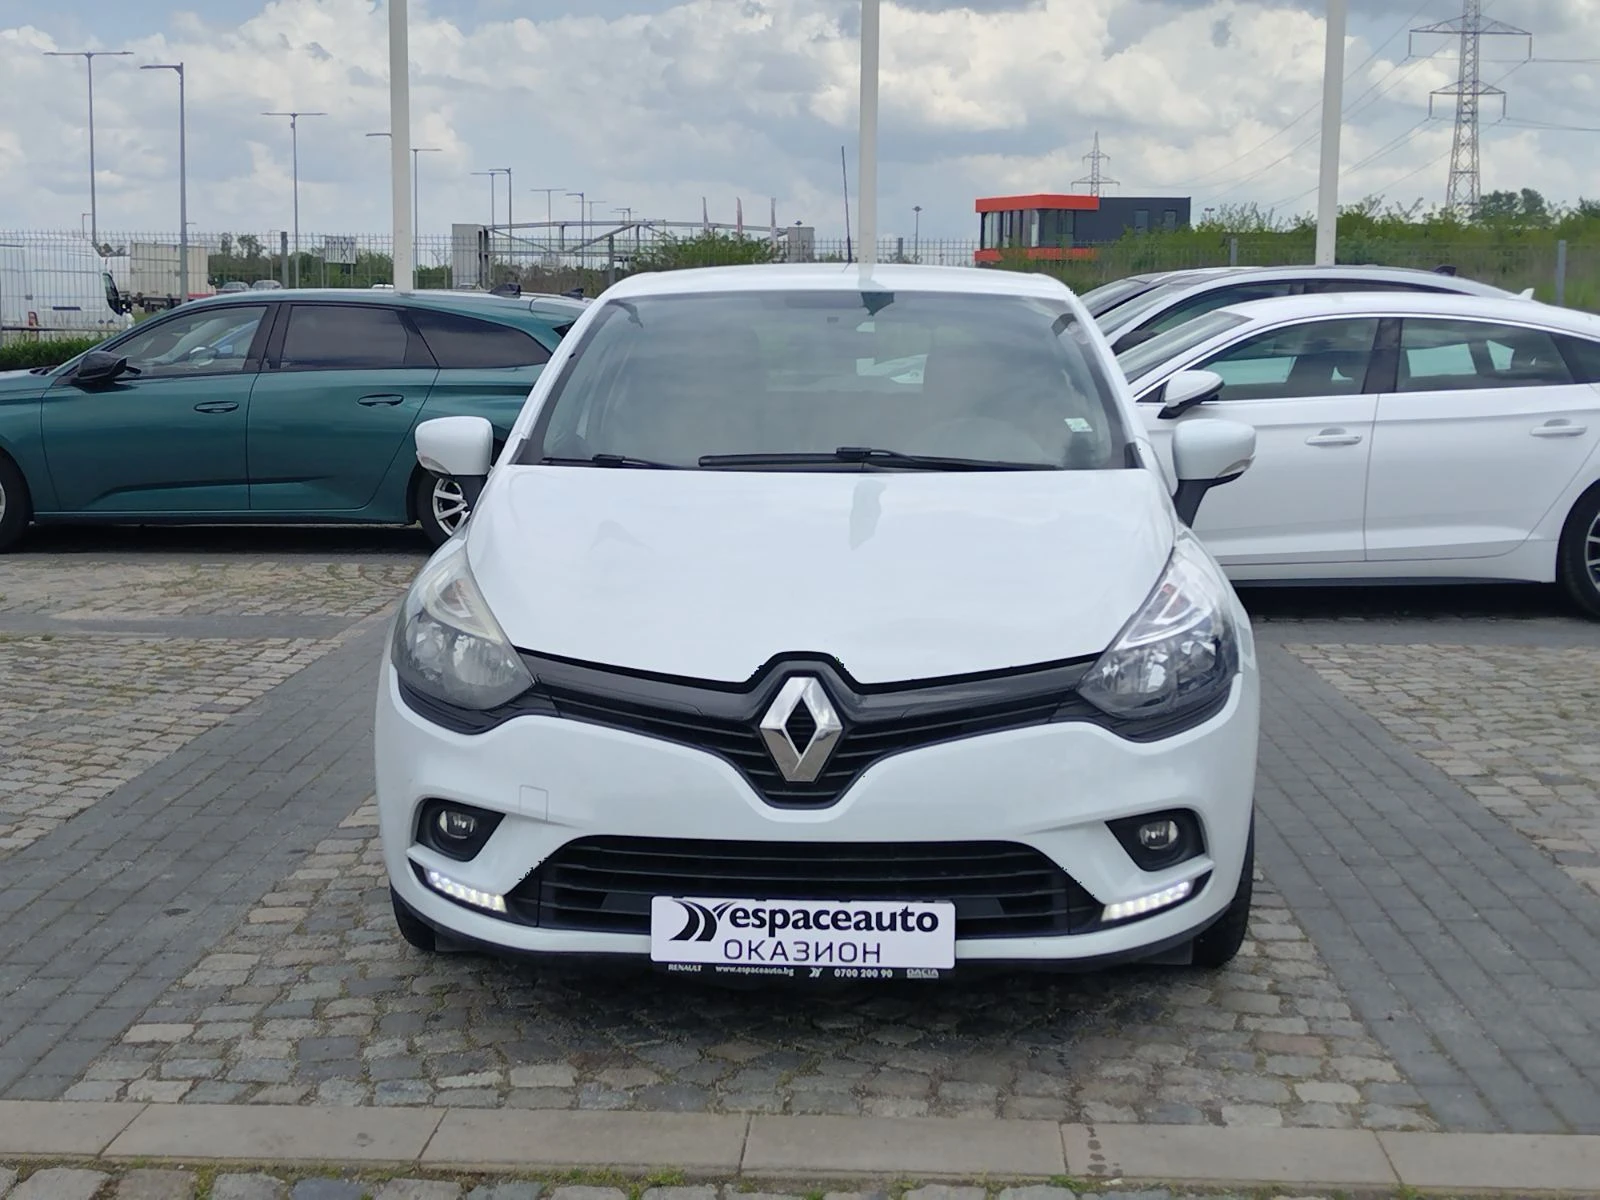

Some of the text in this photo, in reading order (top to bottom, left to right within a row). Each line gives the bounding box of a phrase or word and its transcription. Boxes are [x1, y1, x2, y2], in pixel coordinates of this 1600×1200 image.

[729, 905, 939, 938] espaceauto
[724, 939, 881, 964] ОКАЗИОН
[668, 964, 702, 972] RENAULT
[715, 965, 794, 977] www.espaceauto.bg
[834, 968, 893, 979] 0700 200 90
